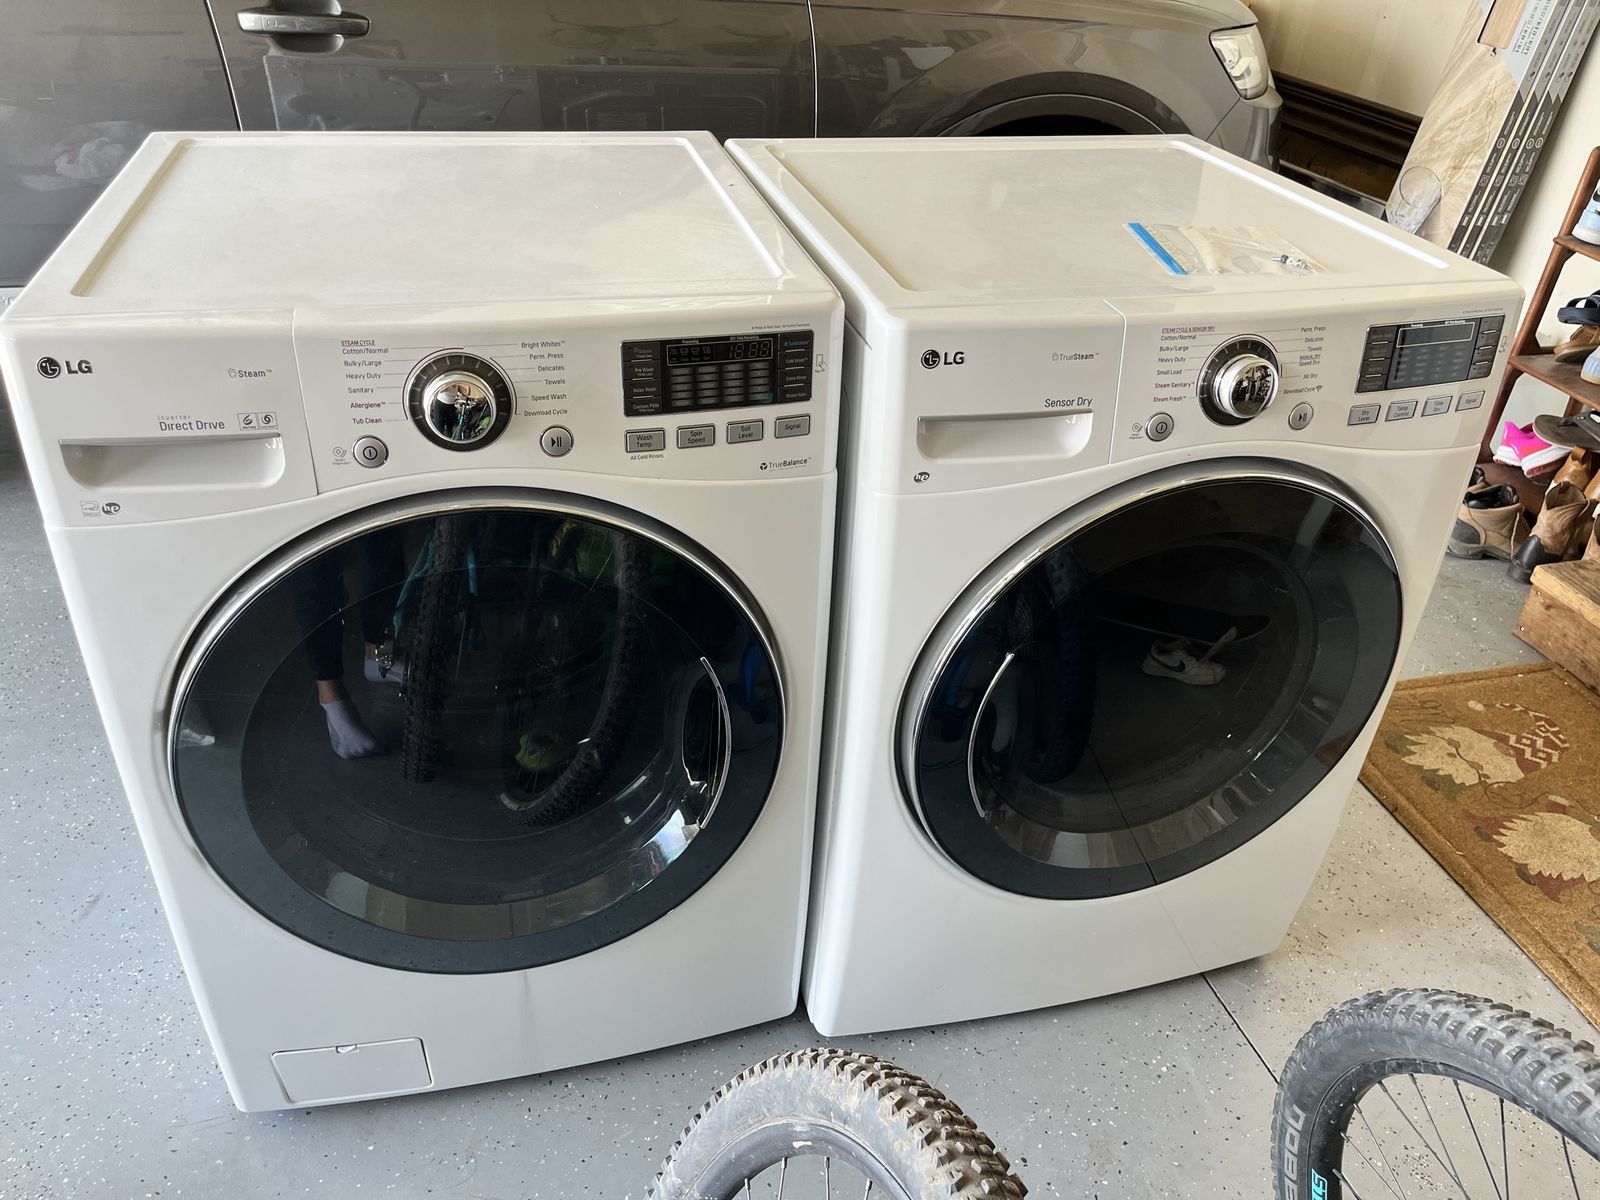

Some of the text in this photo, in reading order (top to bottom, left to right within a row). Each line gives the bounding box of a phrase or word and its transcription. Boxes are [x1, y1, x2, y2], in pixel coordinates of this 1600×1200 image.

[944, 351, 965, 366] LG
[65, 360, 93, 375] LG
[531, 394, 549, 402] Speed
[1153, 396, 1168, 404] Steam
[1045, 397, 1093, 408] Sensor Dry
[523, 408, 568, 417] Download Cycle
[160, 420, 225, 431] Direct Drive
[784, 423, 801, 431] Signal
[738, 431, 754, 439] Level
[688, 436, 706, 444] Speed
[636, 441, 653, 449] Temp
